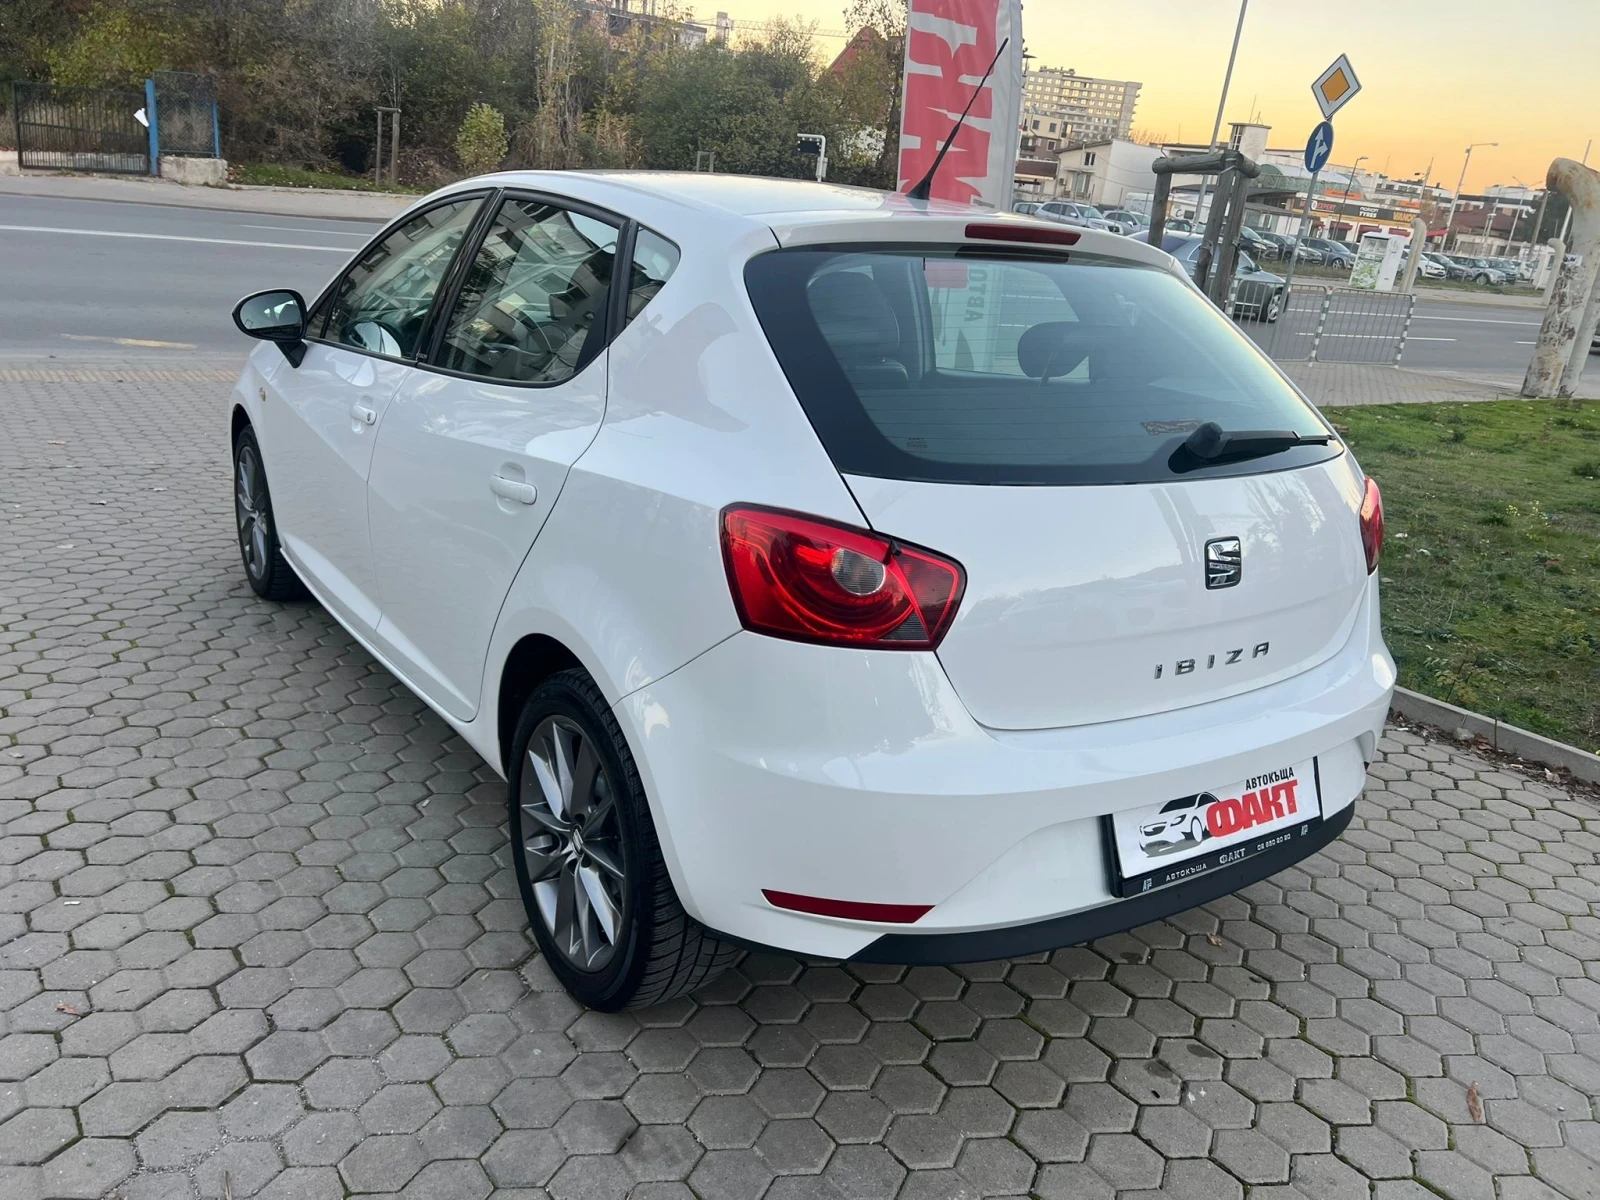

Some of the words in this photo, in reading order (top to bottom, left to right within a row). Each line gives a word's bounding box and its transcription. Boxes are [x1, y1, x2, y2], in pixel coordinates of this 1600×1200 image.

[1154, 641, 1269, 679] IBIZA
[1245, 767, 1294, 791] АВТОКЪЩА
[1206, 779, 1299, 838] ФАКТ
[1219, 848, 1245, 863] ФАКТ
